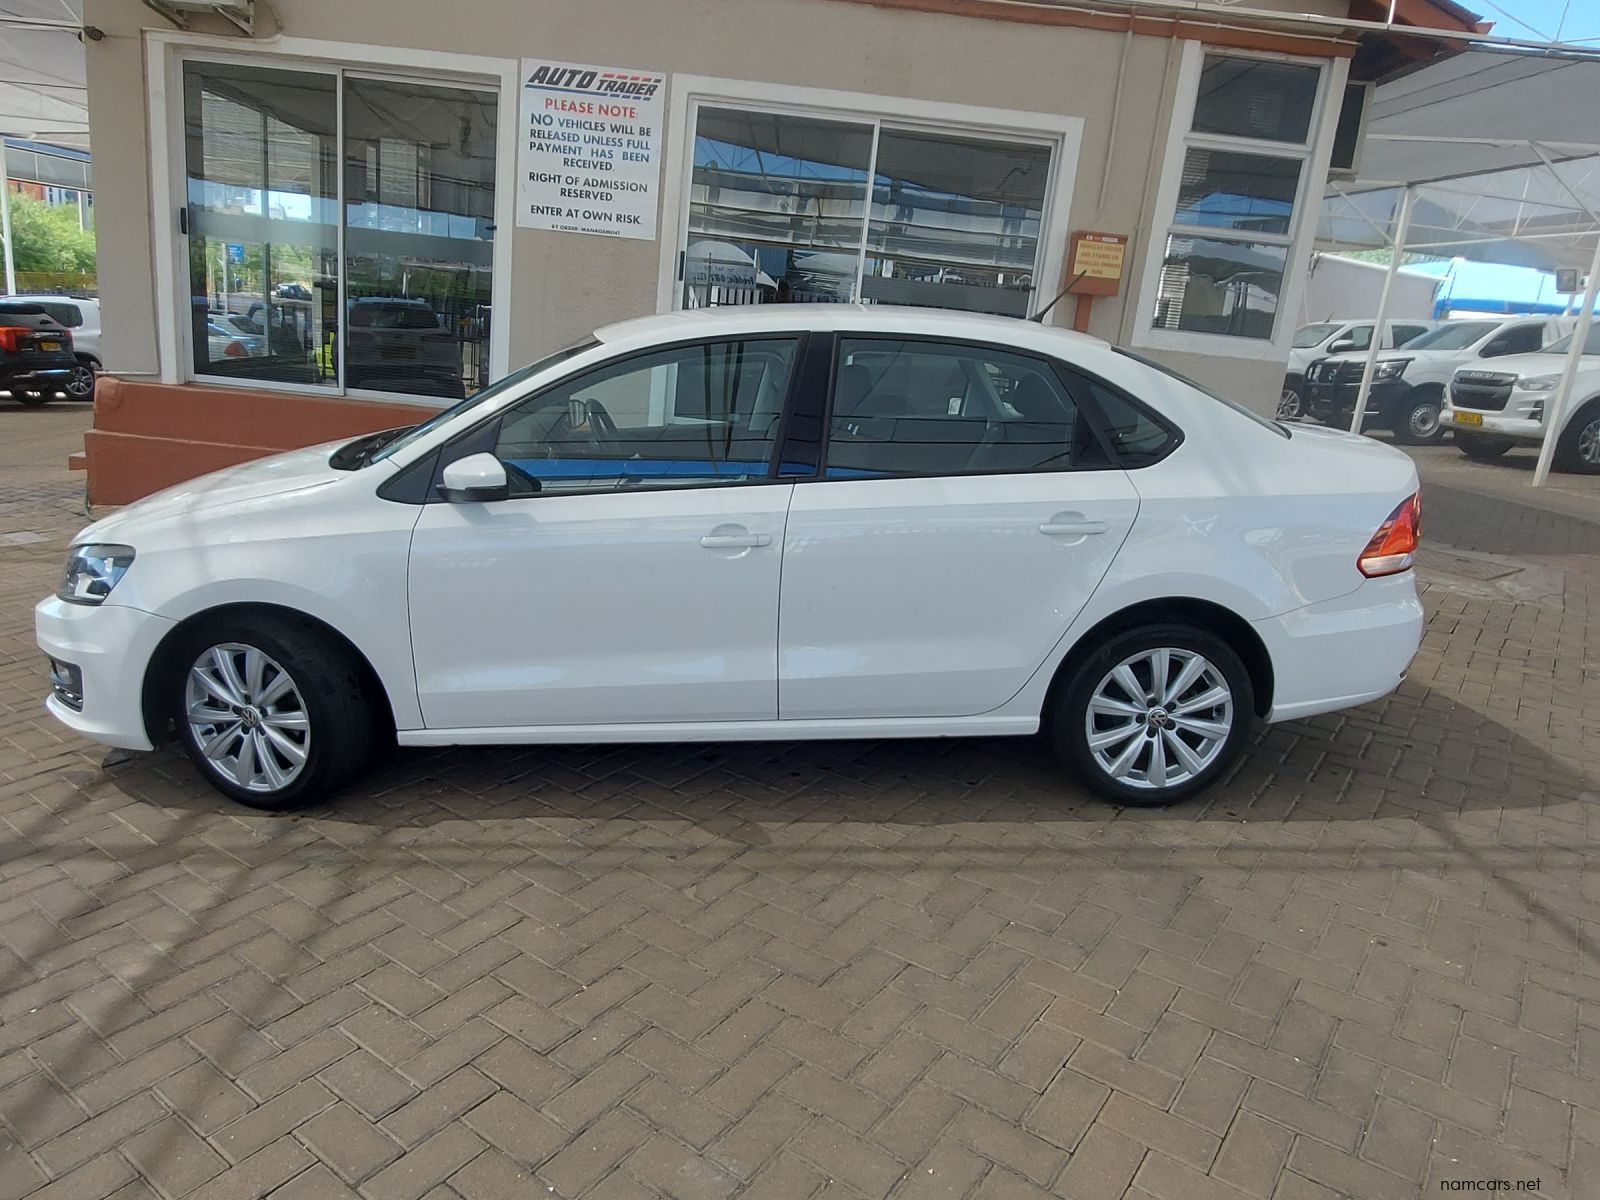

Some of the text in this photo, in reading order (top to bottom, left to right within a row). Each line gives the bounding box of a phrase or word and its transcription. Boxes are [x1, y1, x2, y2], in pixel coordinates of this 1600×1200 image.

[528, 65, 658, 96] AUTO TRADER
[545, 98, 593, 114] PLEASE
[531, 113, 652, 137] NO VEHICLES WILL BE
[530, 128, 651, 151] RELEASED UNLESS FULL
[529, 141, 650, 163] PAYMENT HAS BEEN
[529, 172, 648, 193] RIGHT OF ADMISSION
[530, 204, 563, 217] ENTER
[566, 208, 580, 218] AT
[583, 210, 613, 222] OWN
[581, 227, 621, 235] MANAGEMENT
